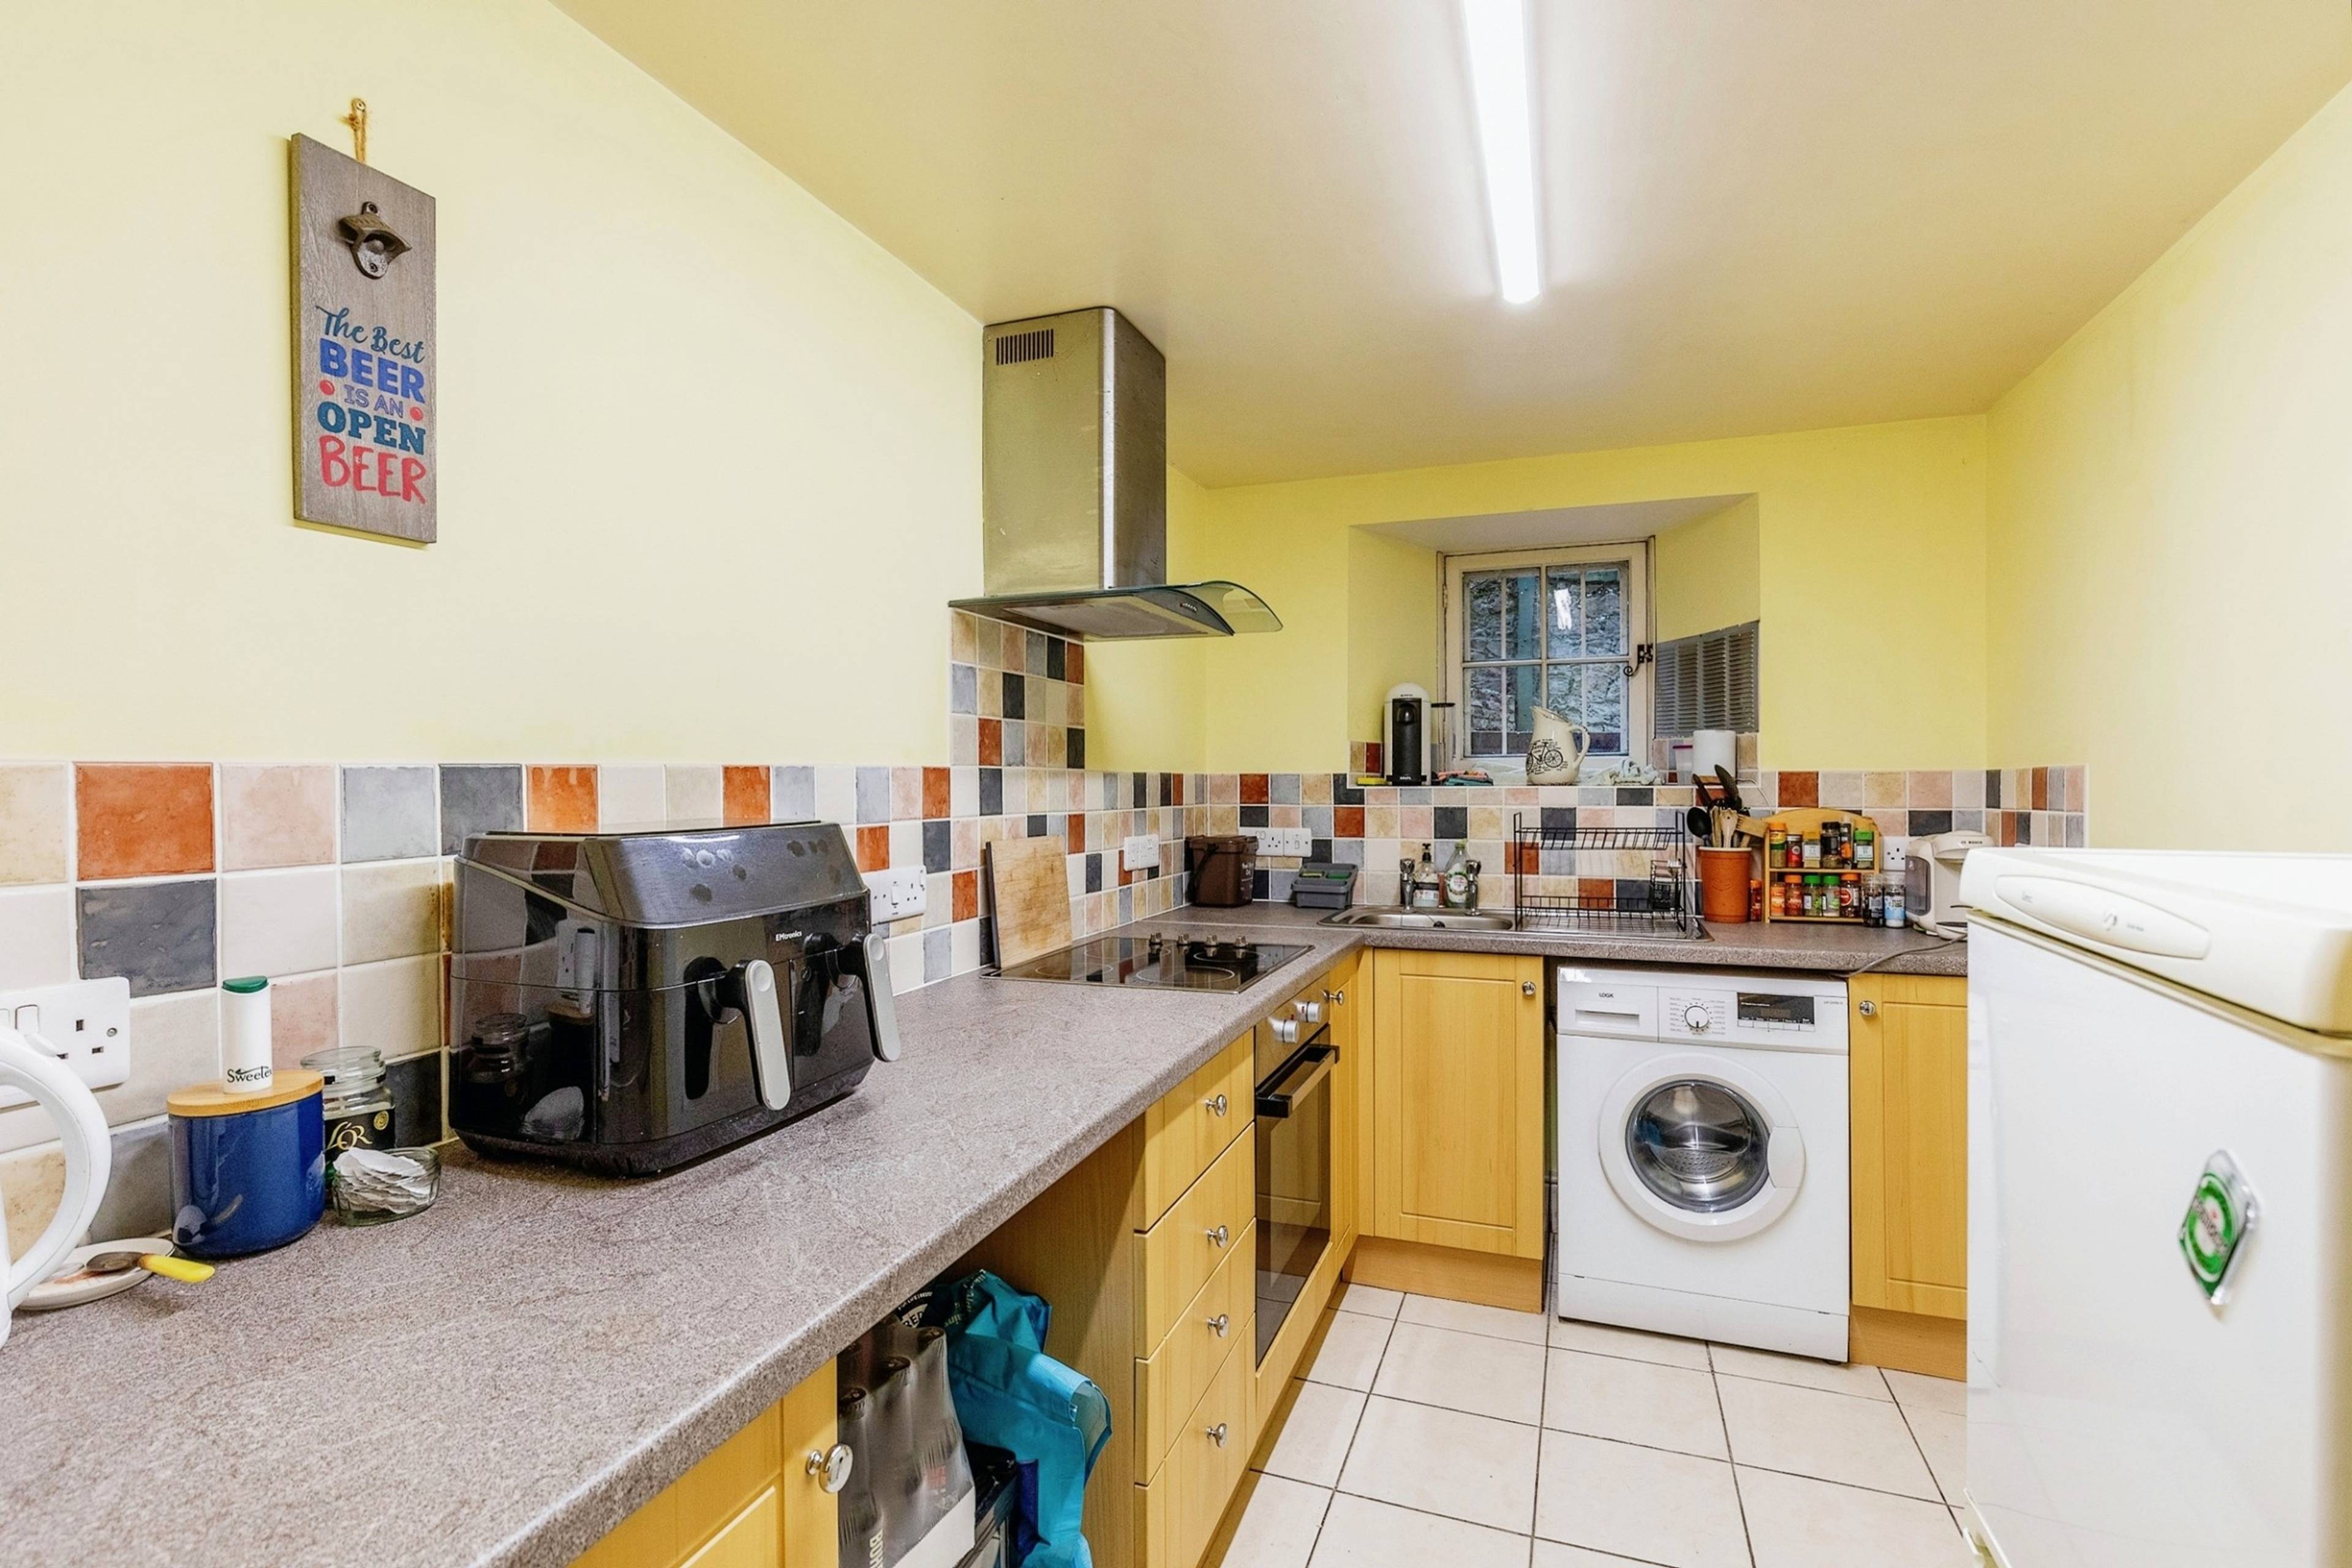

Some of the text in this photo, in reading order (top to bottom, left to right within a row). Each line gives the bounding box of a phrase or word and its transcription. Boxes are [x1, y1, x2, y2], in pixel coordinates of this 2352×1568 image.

[315, 304, 425, 363] The Best
[320, 338, 425, 404] BEER
[317, 401, 426, 455] OPEN
[344, 384, 404, 418] IS AN
[319, 435, 426, 505] BEER
